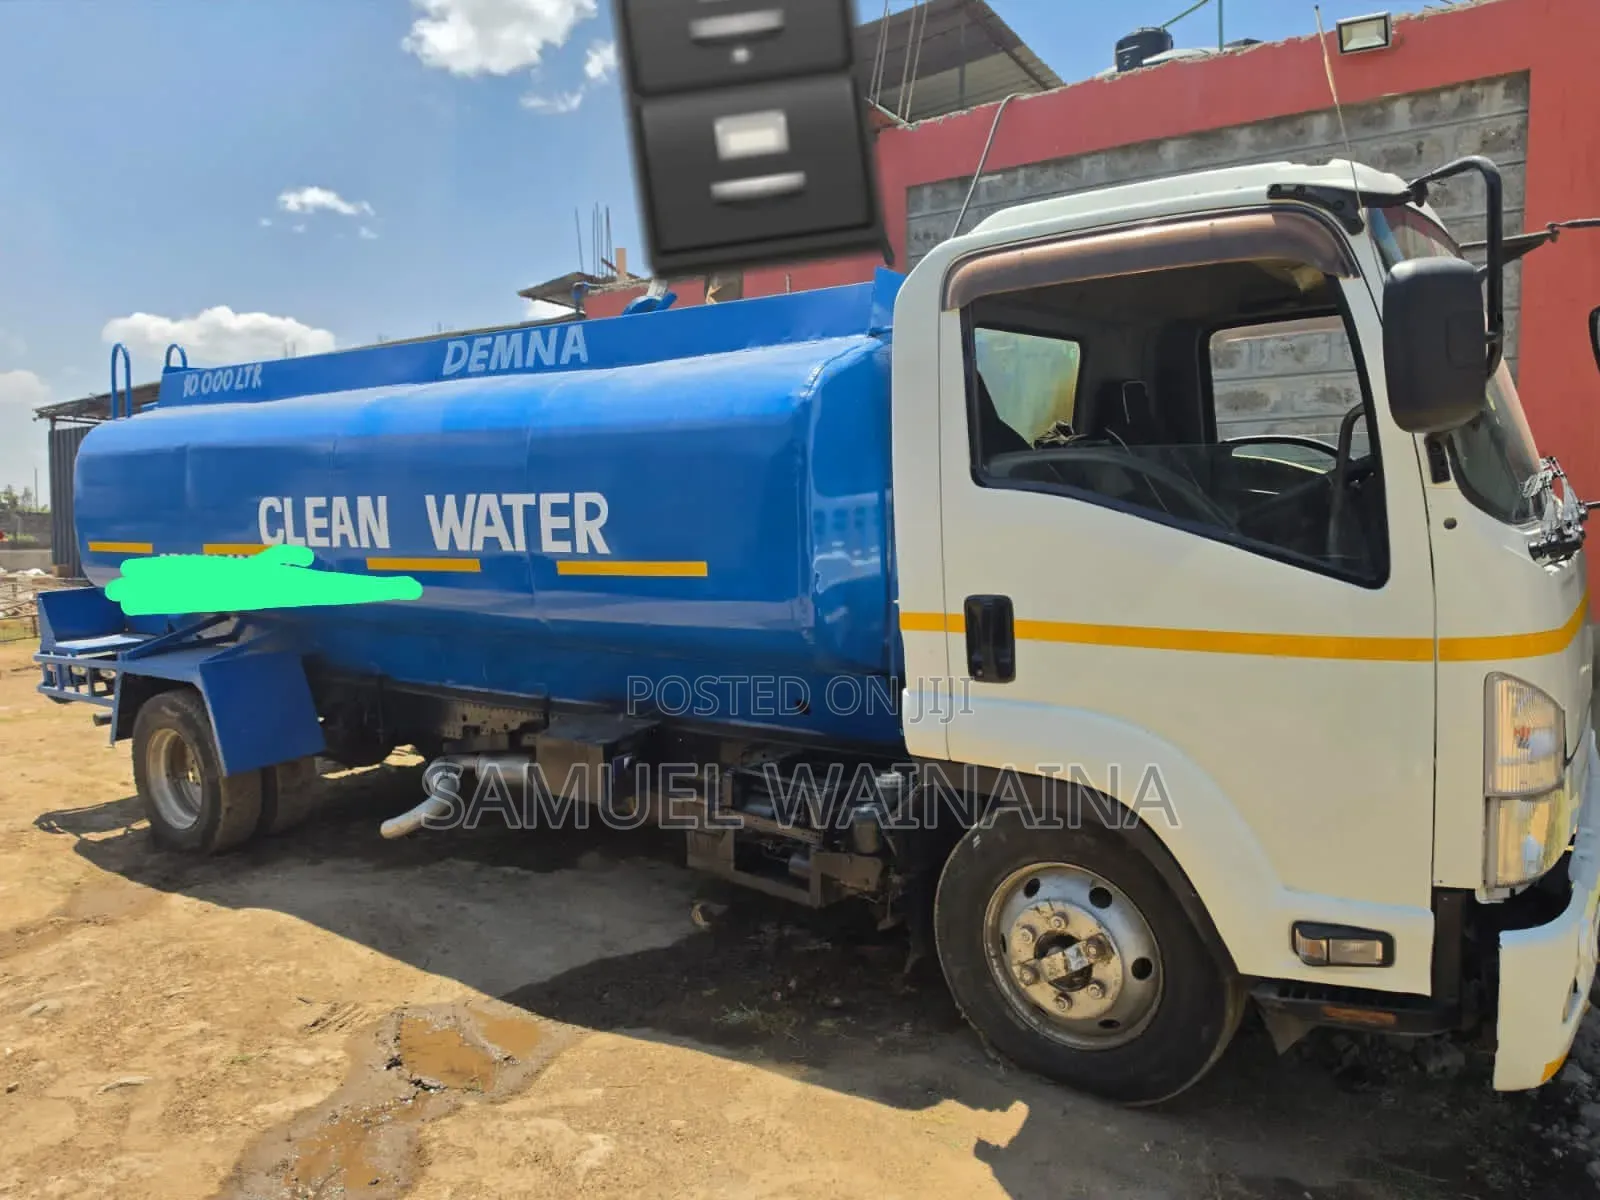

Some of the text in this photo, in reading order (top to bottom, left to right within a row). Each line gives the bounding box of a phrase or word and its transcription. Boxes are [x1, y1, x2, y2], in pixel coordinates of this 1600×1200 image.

[442, 324, 589, 376] DEMNA
[258, 492, 611, 554] CLEAN WATER
